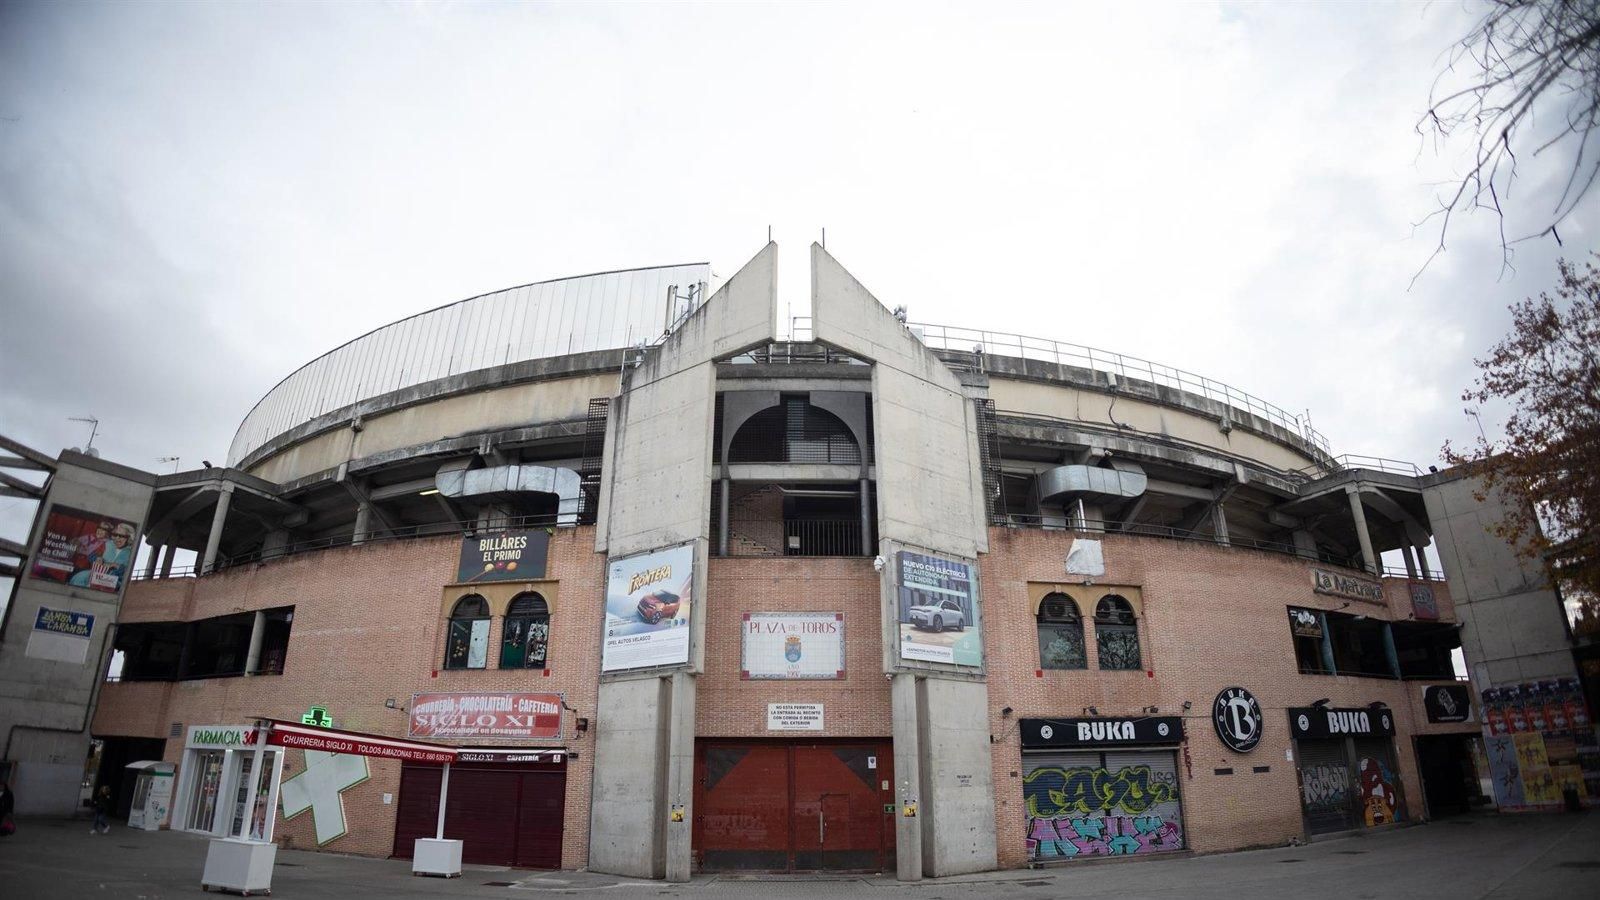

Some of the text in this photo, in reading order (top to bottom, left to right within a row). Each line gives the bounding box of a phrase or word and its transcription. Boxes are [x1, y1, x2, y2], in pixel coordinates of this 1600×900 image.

[47, 531, 60, 540] Ven
[45, 539, 77, 552] Westfield
[479, 536, 527, 551] BILLARES
[483, 549, 522, 561] EL PRIMO
[903, 559, 924, 570] NUEVO
[903, 566, 912, 574] DE
[628, 564, 672, 595] FRONTERA
[750, 622, 786, 634] PLAZA
[801, 622, 837, 634] TOROS
[1220, 689, 1255, 707] BUKA
[459, 695, 512, 712] CHOCOLATERÍA
[518, 698, 559, 715] CAFETERÍA
[415, 714, 535, 727] SIGLO XI
[1327, 711, 1371, 733] BUKA
[1077, 721, 1136, 741] BUKA
[193, 731, 241, 745] FARMACIA
[282, 734, 325, 748] CHURRERIA
[326, 740, 347, 751] SIGLO
[347, 743, 353, 751] XI
[358, 744, 382, 755] TOLDOS
[382, 748, 412, 759] AMAZONAS
[461, 753, 485, 761] SIGLO
[486, 753, 494, 761] XI
